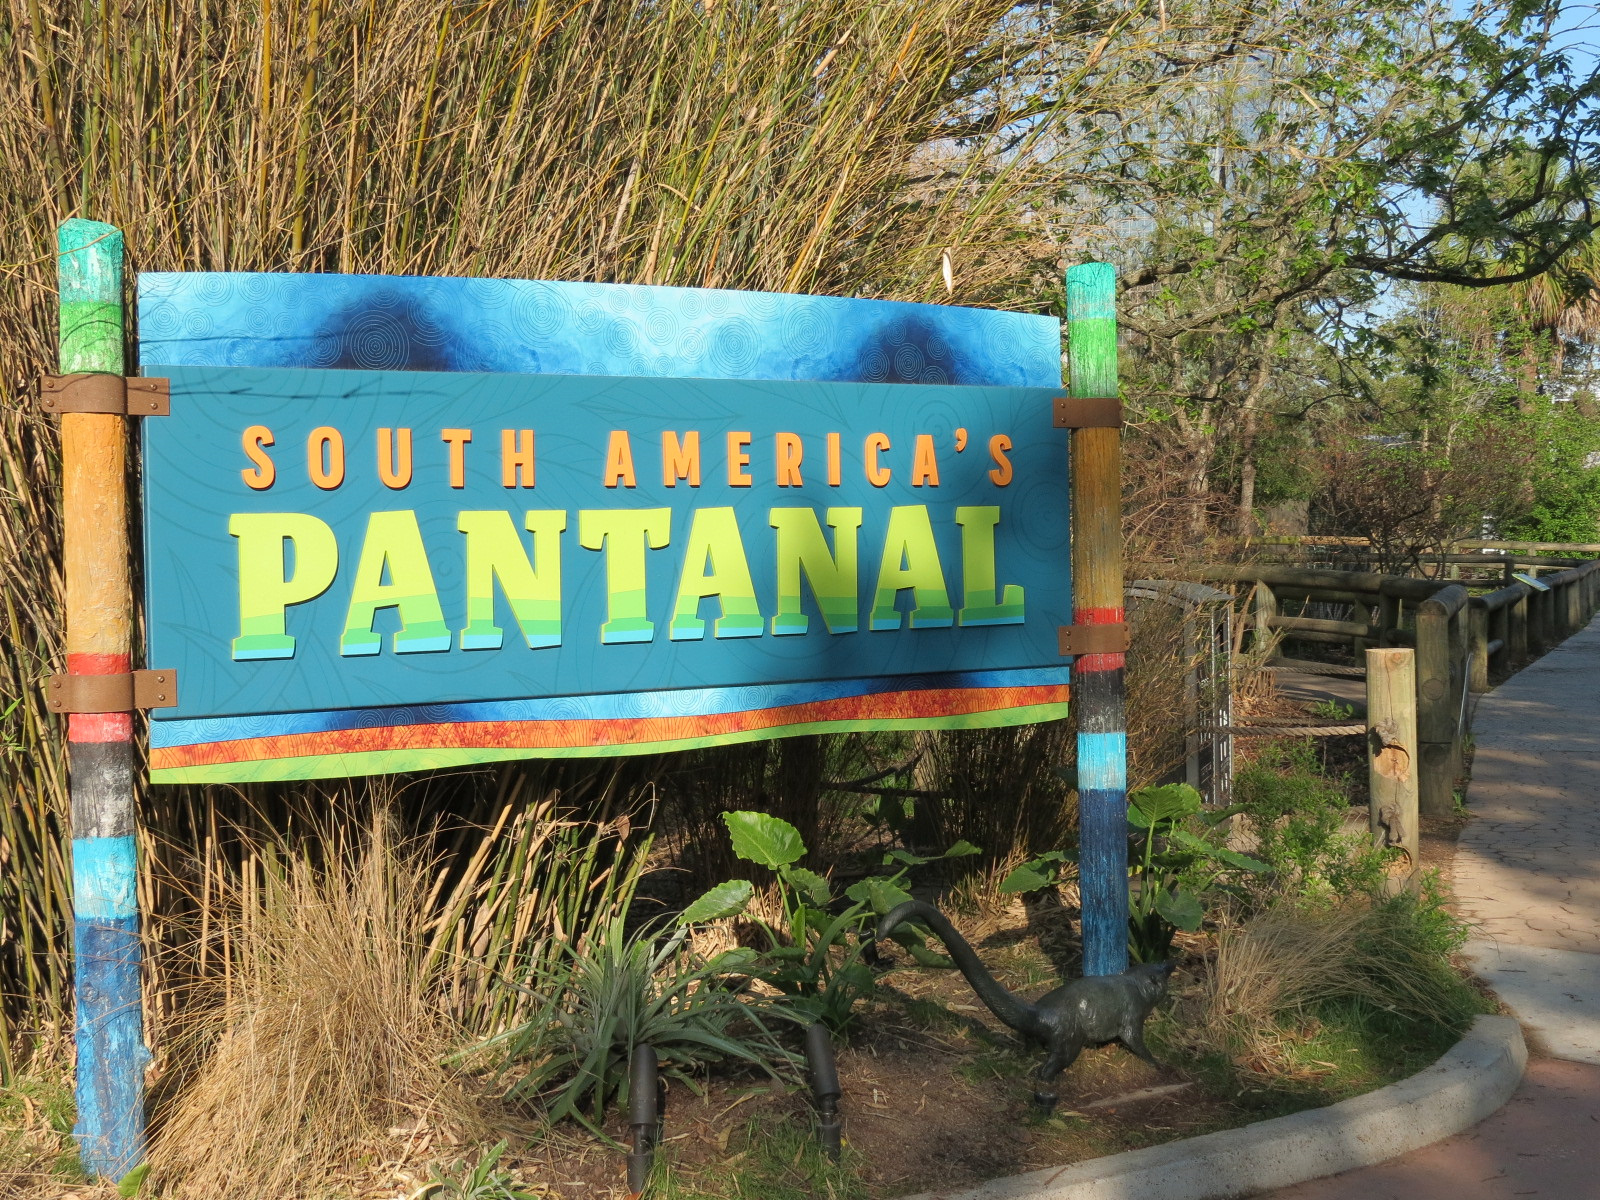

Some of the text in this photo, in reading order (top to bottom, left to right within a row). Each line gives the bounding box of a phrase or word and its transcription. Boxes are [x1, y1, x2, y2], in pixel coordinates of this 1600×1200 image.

[241, 425, 1013, 490] SOUTH AMERICA'S
[228, 505, 1025, 661] PANTANAL
